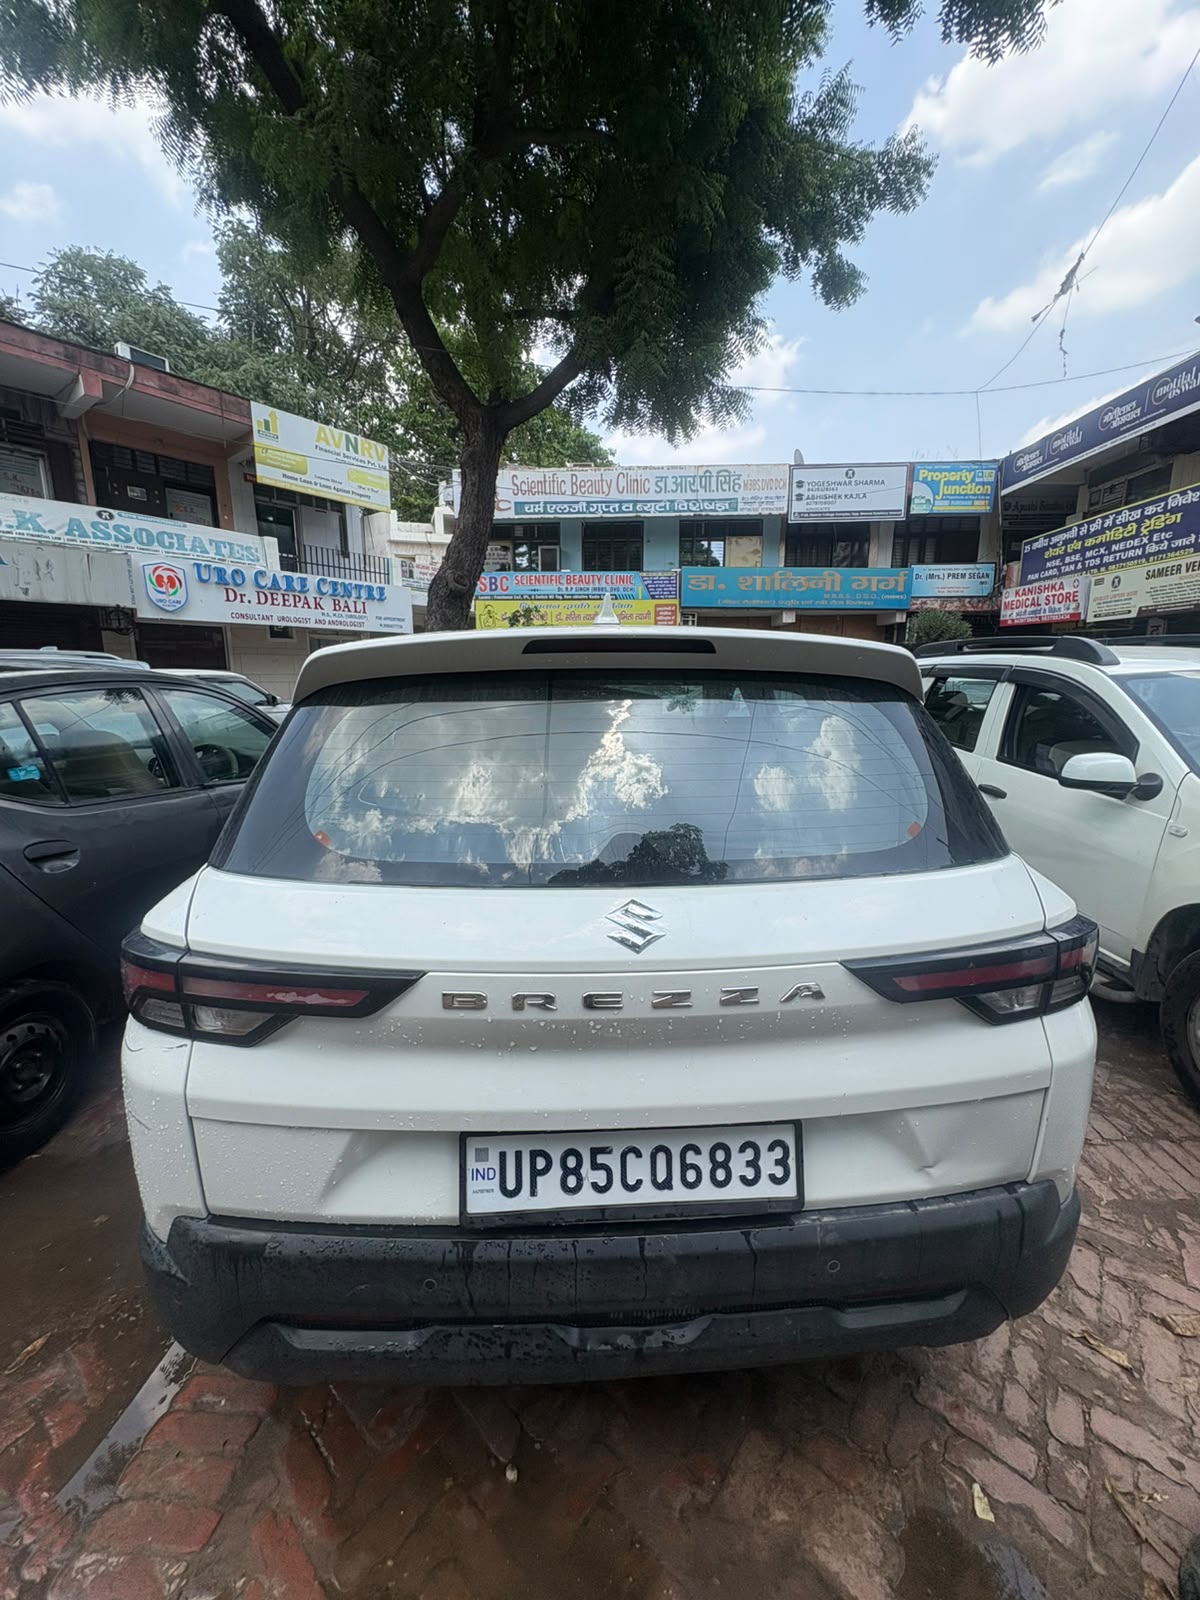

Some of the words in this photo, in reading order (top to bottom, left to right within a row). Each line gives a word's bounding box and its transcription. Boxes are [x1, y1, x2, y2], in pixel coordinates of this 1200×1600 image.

[1156, 366, 1197, 398] motilal
[315, 425, 385, 462] AVNRV
[315, 444, 341, 457] Financial
[342, 453, 366, 465] Services
[282, 473, 299, 482] Home
[300, 477, 313, 486] Loan
[333, 486, 350, 496] Against
[351, 489, 371, 500] Property
[511, 473, 567, 496] Scientific
[570, 473, 613, 497] Beauty
[616, 472, 650, 495] Clinic
[918, 469, 975, 483] Property
[805, 493, 843, 501] ABHISHEK
[935, 480, 991, 499] Junction
[621, 502, 633, 511] व
[1050, 527, 1078, 547] अनुभवी
[1080, 524, 1088, 536] से
[1089, 518, 1103, 534] फ्री
[1103, 514, 1115, 527] में
[1116, 509, 1142, 524] सीख
[1144, 501, 1166, 515] कर
[0, 510, 56, 534] .K.
[65, 517, 260, 562] ASSOCIATES
[1044, 546, 1065, 559] शेयर
[1084, 523, 1137, 547] कमोडिटी
[1140, 512, 1183, 536] ट्रेडिंग
[1027, 572, 1039, 581] PAN
[1040, 569, 1059, 578] CARD,
[1061, 564, 1075, 573] TAN
[1076, 562, 1082, 570] &
[1084, 557, 1101, 567] TDS
[1102, 547, 1143, 563] RETURN
[1145, 540, 1169, 555] किये
[1171, 533, 1196, 548] जाते
[1046, 560, 1063, 568] NSE,
[1065, 554, 1083, 564] BSE,
[1085, 546, 1108, 558] MCX,
[1111, 536, 1149, 552] NEDEX
[1152, 531, 1173, 542] Etc
[193, 562, 246, 587] URO
[254, 569, 309, 594] CARE
[316, 577, 387, 601] CENTRE
[514, 574, 563, 586] SCIENTIFIC
[565, 574, 602, 585] BEAUTY
[604, 574, 634, 585] CLINIC
[737, 570, 842, 592] शालिनी
[851, 571, 908, 592] गर्ग
[925, 572, 946, 581] (Mrs.)
[947, 572, 967, 580] PREM
[1145, 563, 1182, 581] SAMEER
[479, 575, 509, 593] SBC
[1014, 581, 1065, 598] KANISHKA
[224, 587, 251, 604] Dr.
[255, 590, 325, 611] DEEPAK
[332, 598, 368, 614] BALI
[1003, 596, 1042, 611] MEDICAL
[1044, 591, 1079, 606] STORE
[231, 612, 273, 621] CONSULTANT
[277, 616, 311, 625] UROLOGIST
[328, 619, 365, 628] ANDROLOGIST
[442, 981, 825, 1010] BREZZA
[471, 1167, 496, 1181] IND
[499, 1139, 790, 1199] UP85CQ6833
